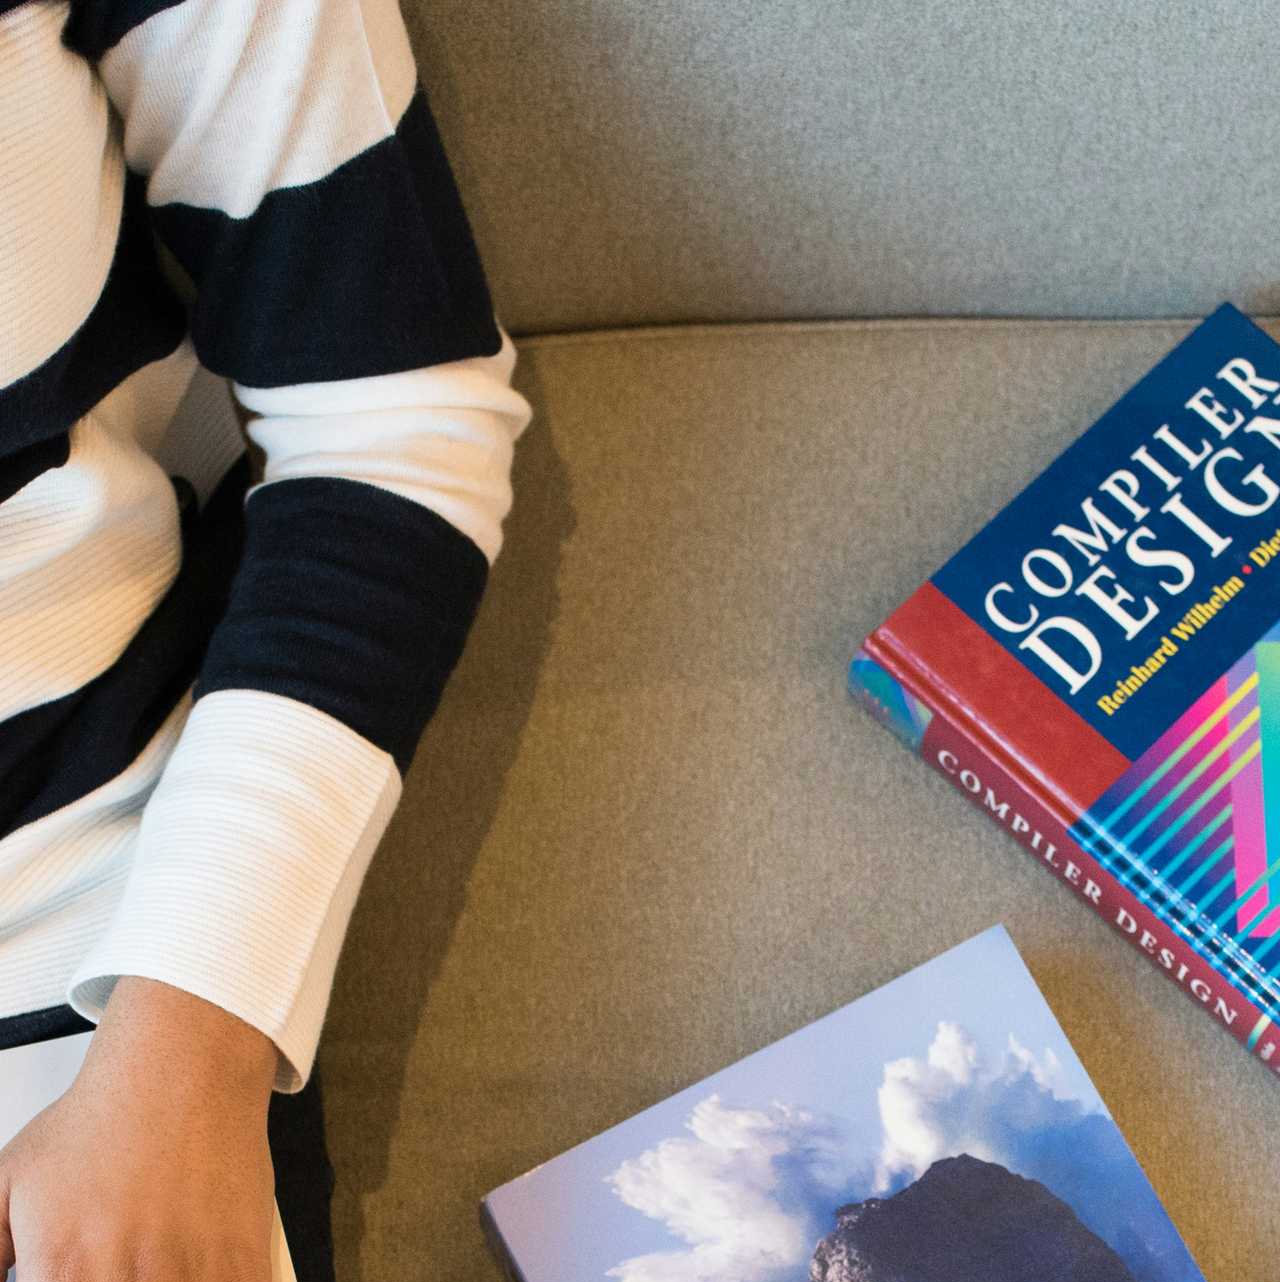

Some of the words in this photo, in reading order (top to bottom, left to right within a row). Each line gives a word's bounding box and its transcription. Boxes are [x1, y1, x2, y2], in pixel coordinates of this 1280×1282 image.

[985, 358, 1280, 633] COMPILER
[1097, 636, 1179, 716] Reinhard
[1171, 575, 1244, 641] Wilhelm
[933, 749, 1107, 908] COMPILER
[1110, 906, 1239, 1027] DESIGN
